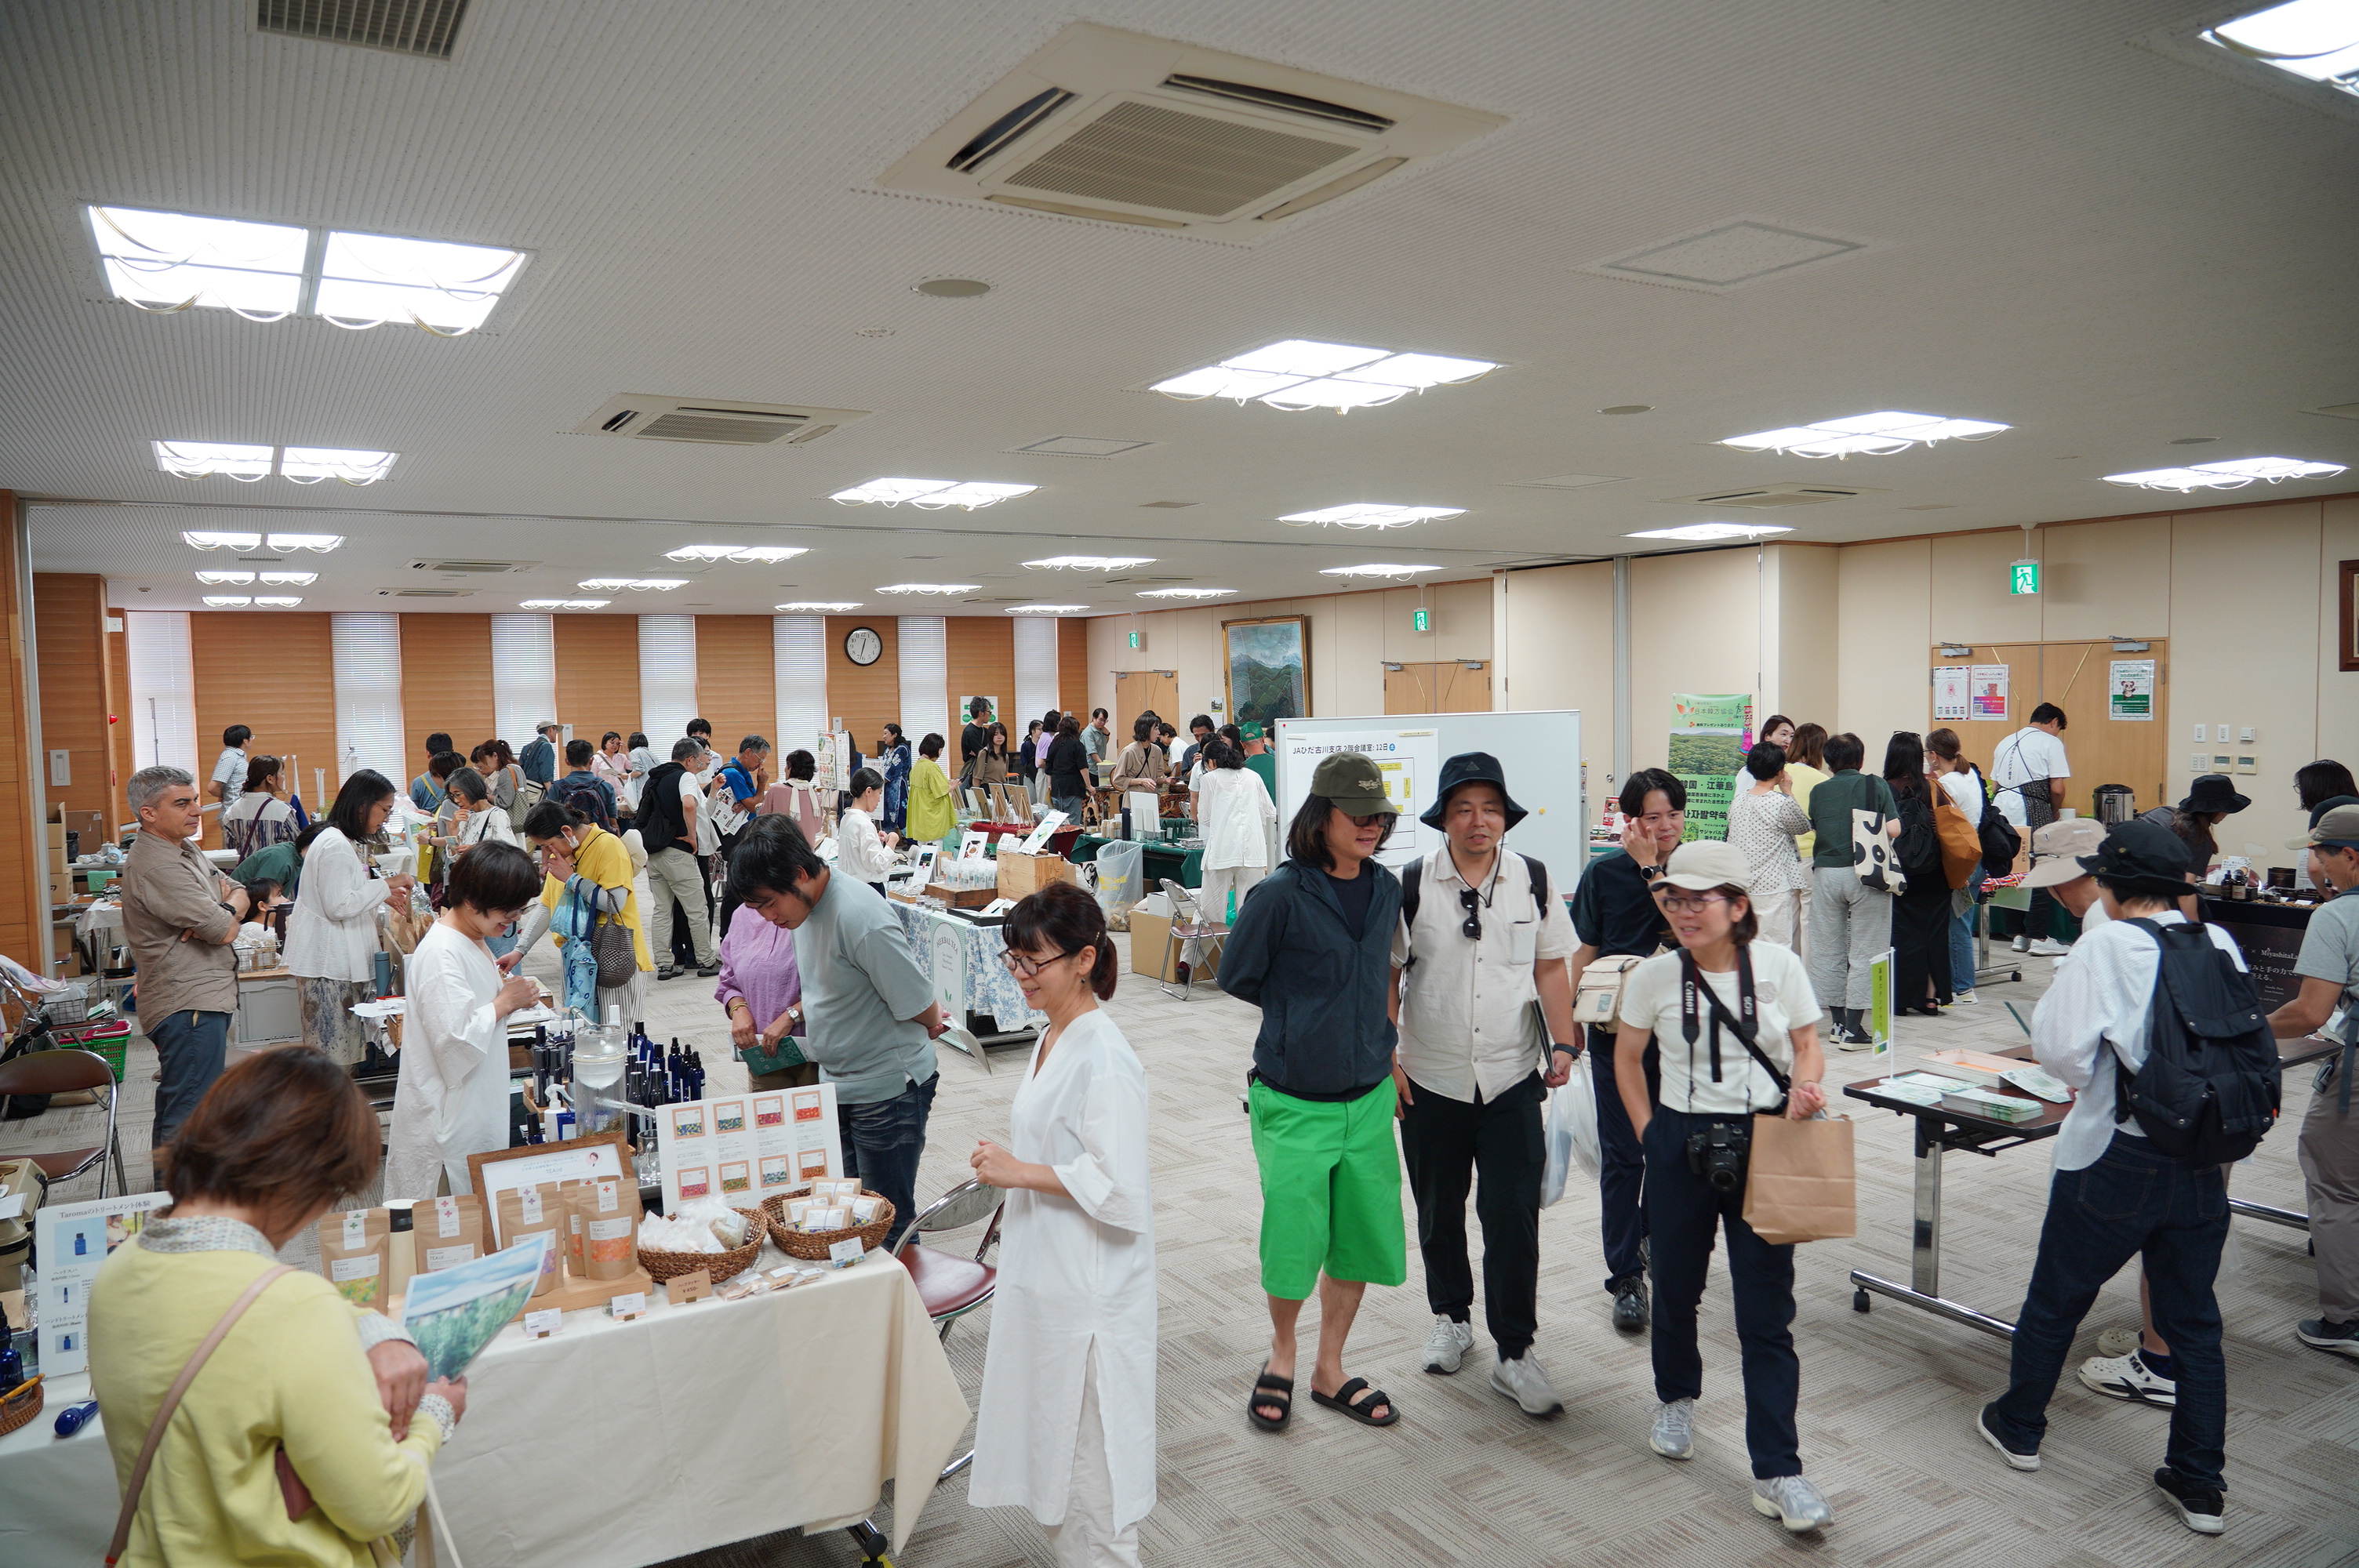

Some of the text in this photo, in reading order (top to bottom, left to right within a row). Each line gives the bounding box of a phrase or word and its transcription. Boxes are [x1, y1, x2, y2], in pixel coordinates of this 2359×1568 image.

[936, 937, 951, 949] HERBAL
[1685, 981, 1695, 1014] Canon
[59, 1200, 151, 1218] Taromaのトリートメント体験
